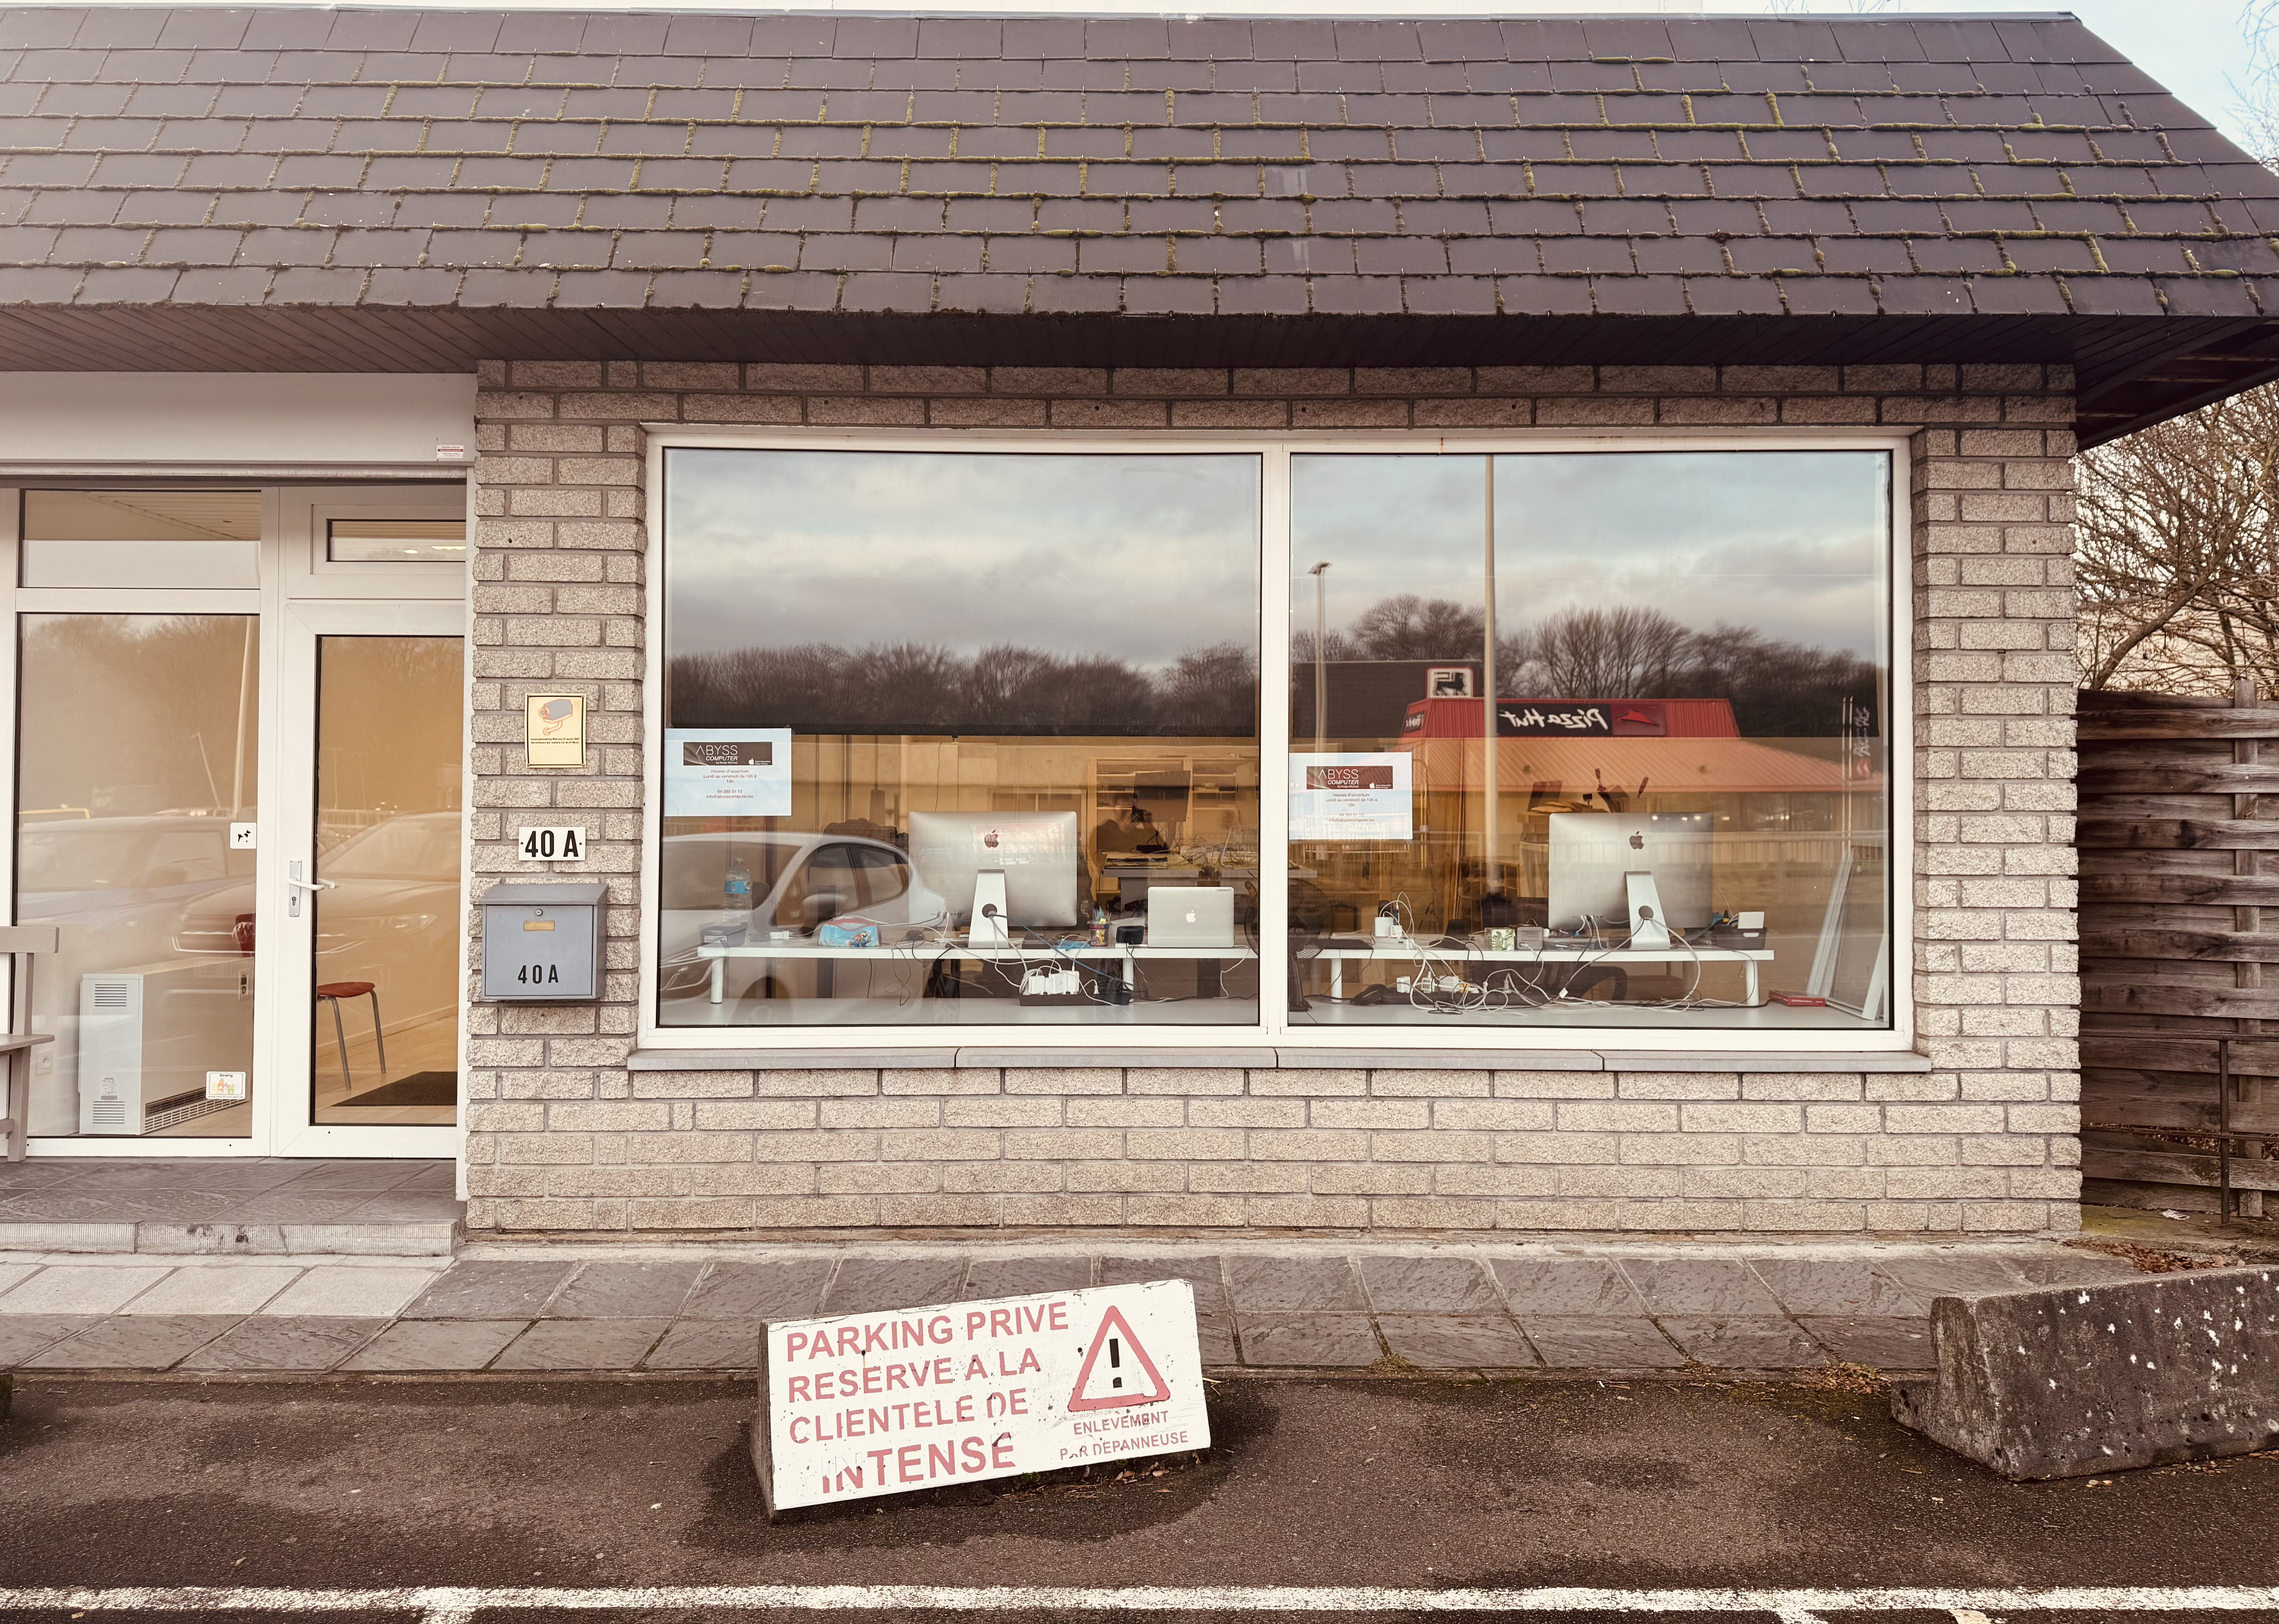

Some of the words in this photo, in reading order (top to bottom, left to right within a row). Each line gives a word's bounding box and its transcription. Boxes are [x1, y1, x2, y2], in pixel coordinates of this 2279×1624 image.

[695, 745, 738, 755] ABYSS
[1318, 769, 1359, 779] ABYSS
[525, 830, 554, 857] 40
[563, 830, 579, 857] A
[788, 1316, 952, 1362] PARKING
[967, 1302, 1068, 1340] PRIVE
[789, 1357, 953, 1403] RESERVE
[965, 1354, 988, 1381] A
[999, 1348, 1040, 1376] LA
[790, 1395, 974, 1444] CLIENTELE
[987, 1388, 1028, 1418] DE
[1074, 1411, 1168, 1435] ENLEVEMENT
[1092, 1431, 1189, 1455] DEPANNEUSE
